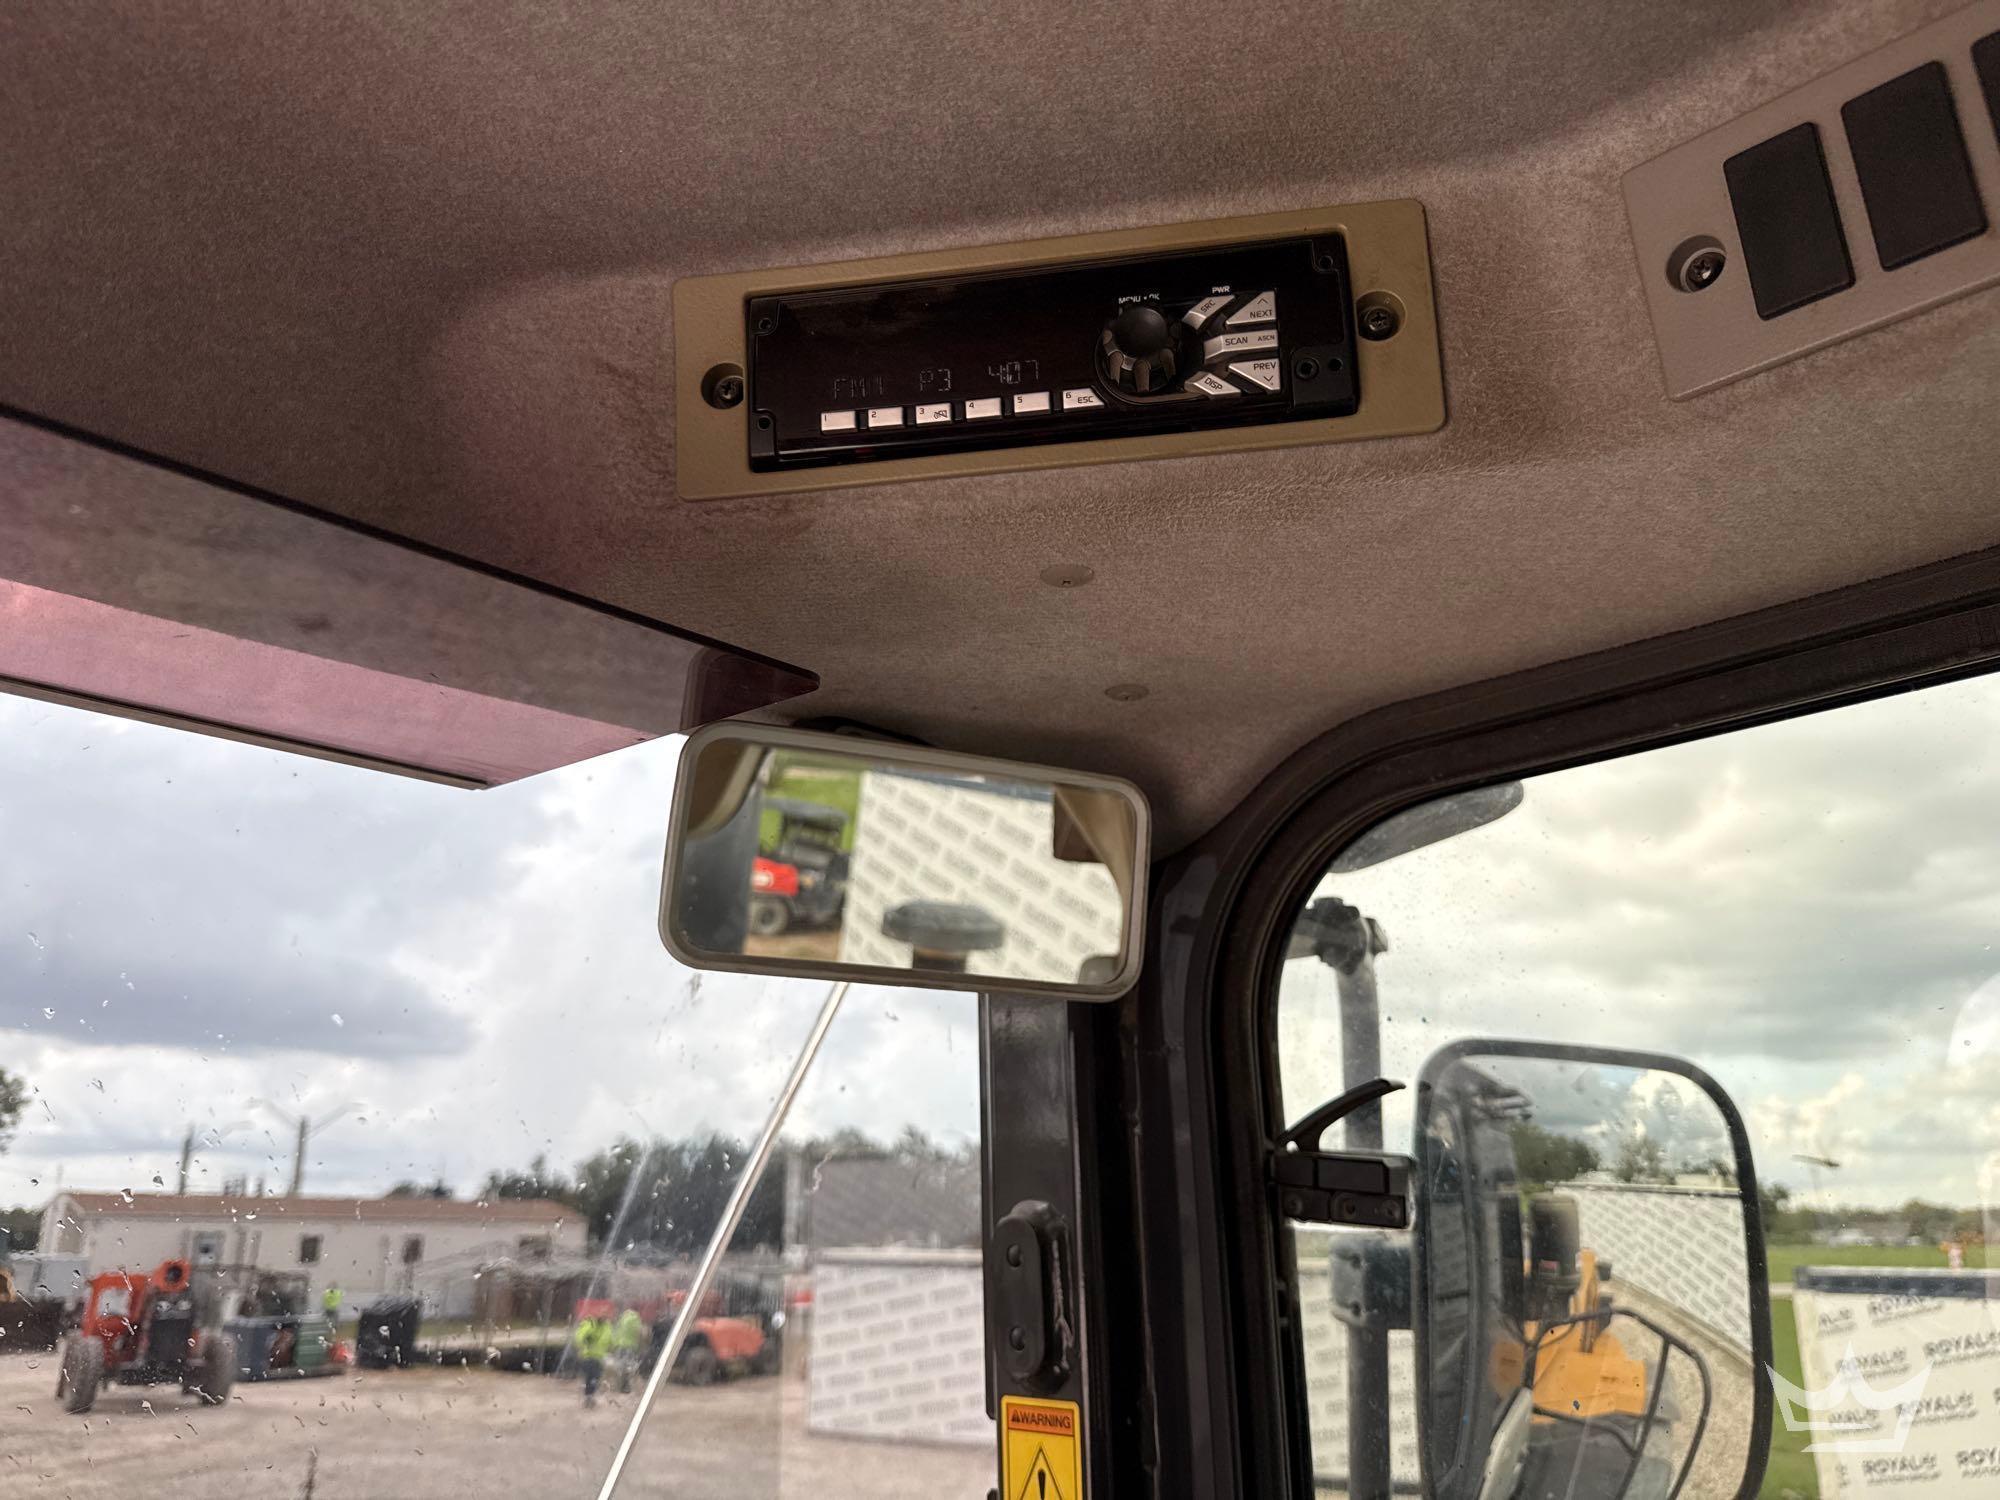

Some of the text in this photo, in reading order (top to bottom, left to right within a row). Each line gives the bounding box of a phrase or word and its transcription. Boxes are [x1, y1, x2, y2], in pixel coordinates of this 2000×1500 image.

[1212, 286, 1230, 294] PWR
[1200, 300, 1216, 313] SRC
[1250, 309, 1273, 318] NEXT
[1225, 336, 1248, 345] SCAN
[1253, 362, 1276, 370] PREV
[919, 368, 951, 391] P3
[1204, 377, 1223, 390] DISP
[1078, 395, 1094, 403] ESC
[919, 407, 924, 415] 3
[1020, 1411, 1072, 1428] WARNING
